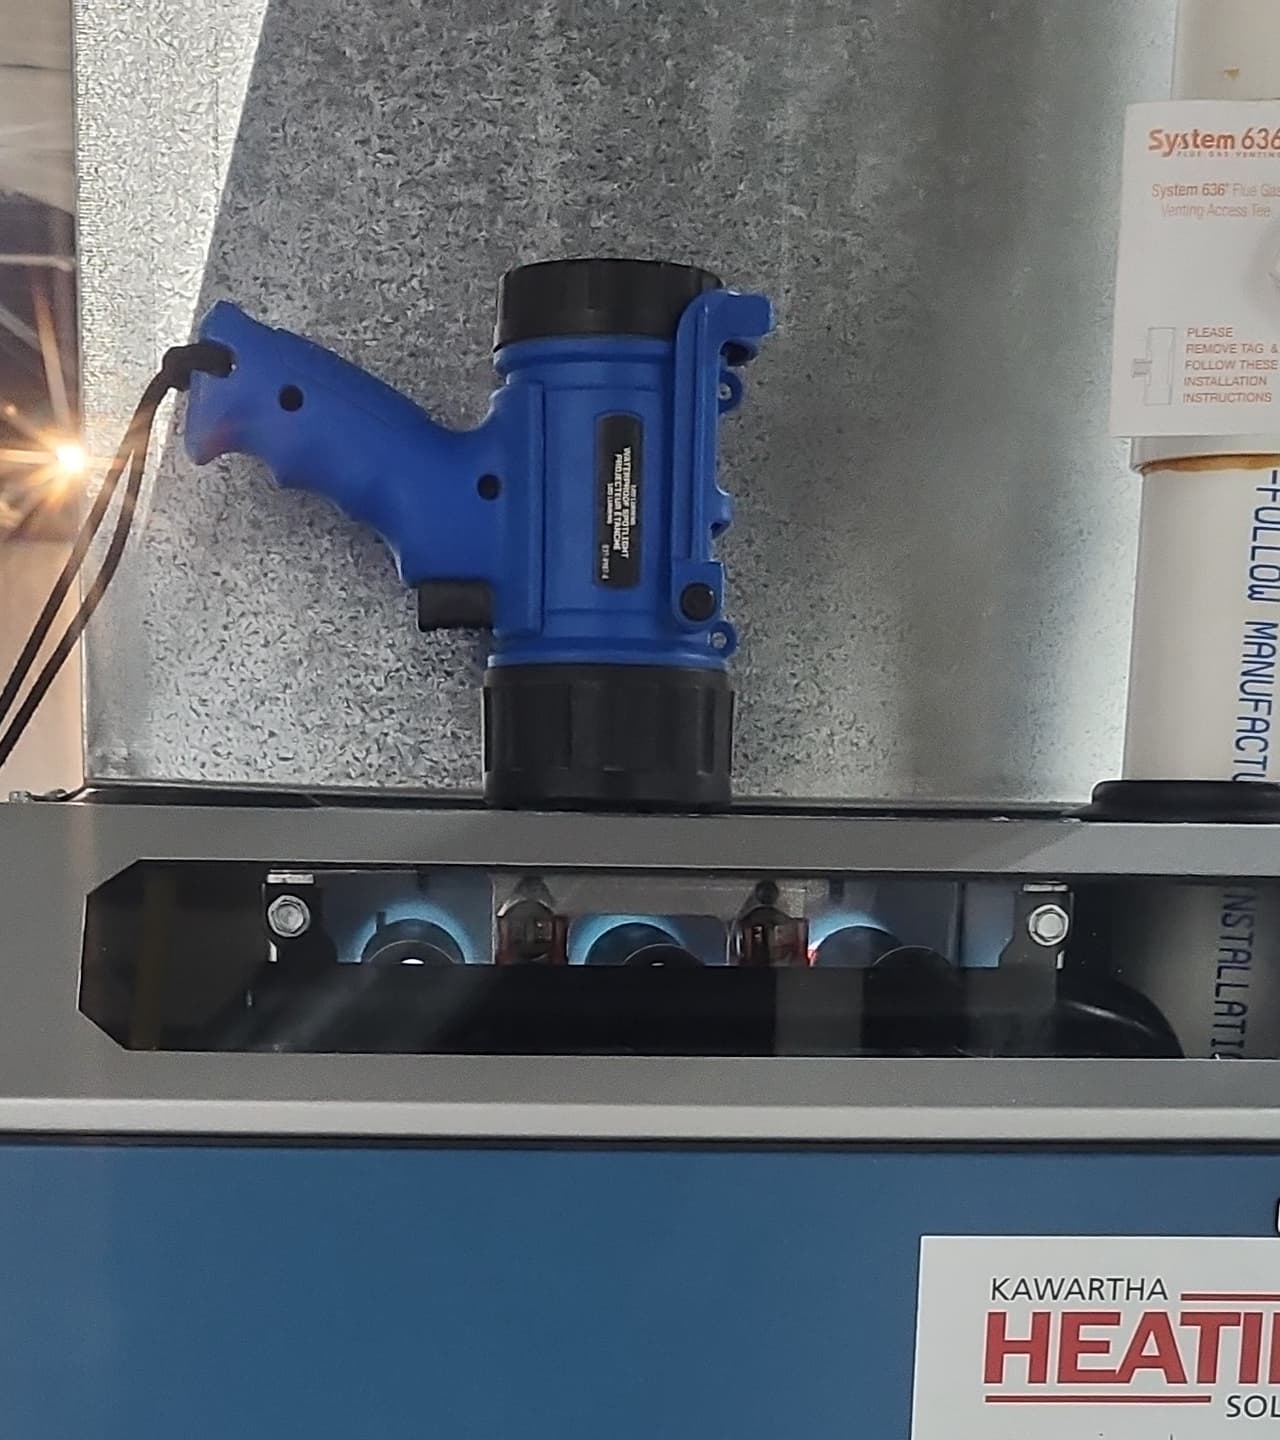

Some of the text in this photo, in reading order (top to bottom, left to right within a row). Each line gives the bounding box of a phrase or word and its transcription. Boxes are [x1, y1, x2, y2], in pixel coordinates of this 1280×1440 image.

[1148, 129, 1235, 157] System
[1152, 184, 1197, 198] System
[1161, 204, 1204, 219] Venting
[1207, 204, 1247, 217] Access
[1187, 327, 1233, 338] PLEASE
[1185, 343, 1237, 354] REMOVE
[1241, 343, 1264, 354] TAG
[1185, 359, 1279, 370] FOLLOW THESE
[1183, 376, 1267, 387] INSTALLATION
[1183, 392, 1272, 403] INSTRUCTIONS
[620, 447, 631, 508] WATERPROOF
[990, 1277, 1169, 1302] KAWARTHA
